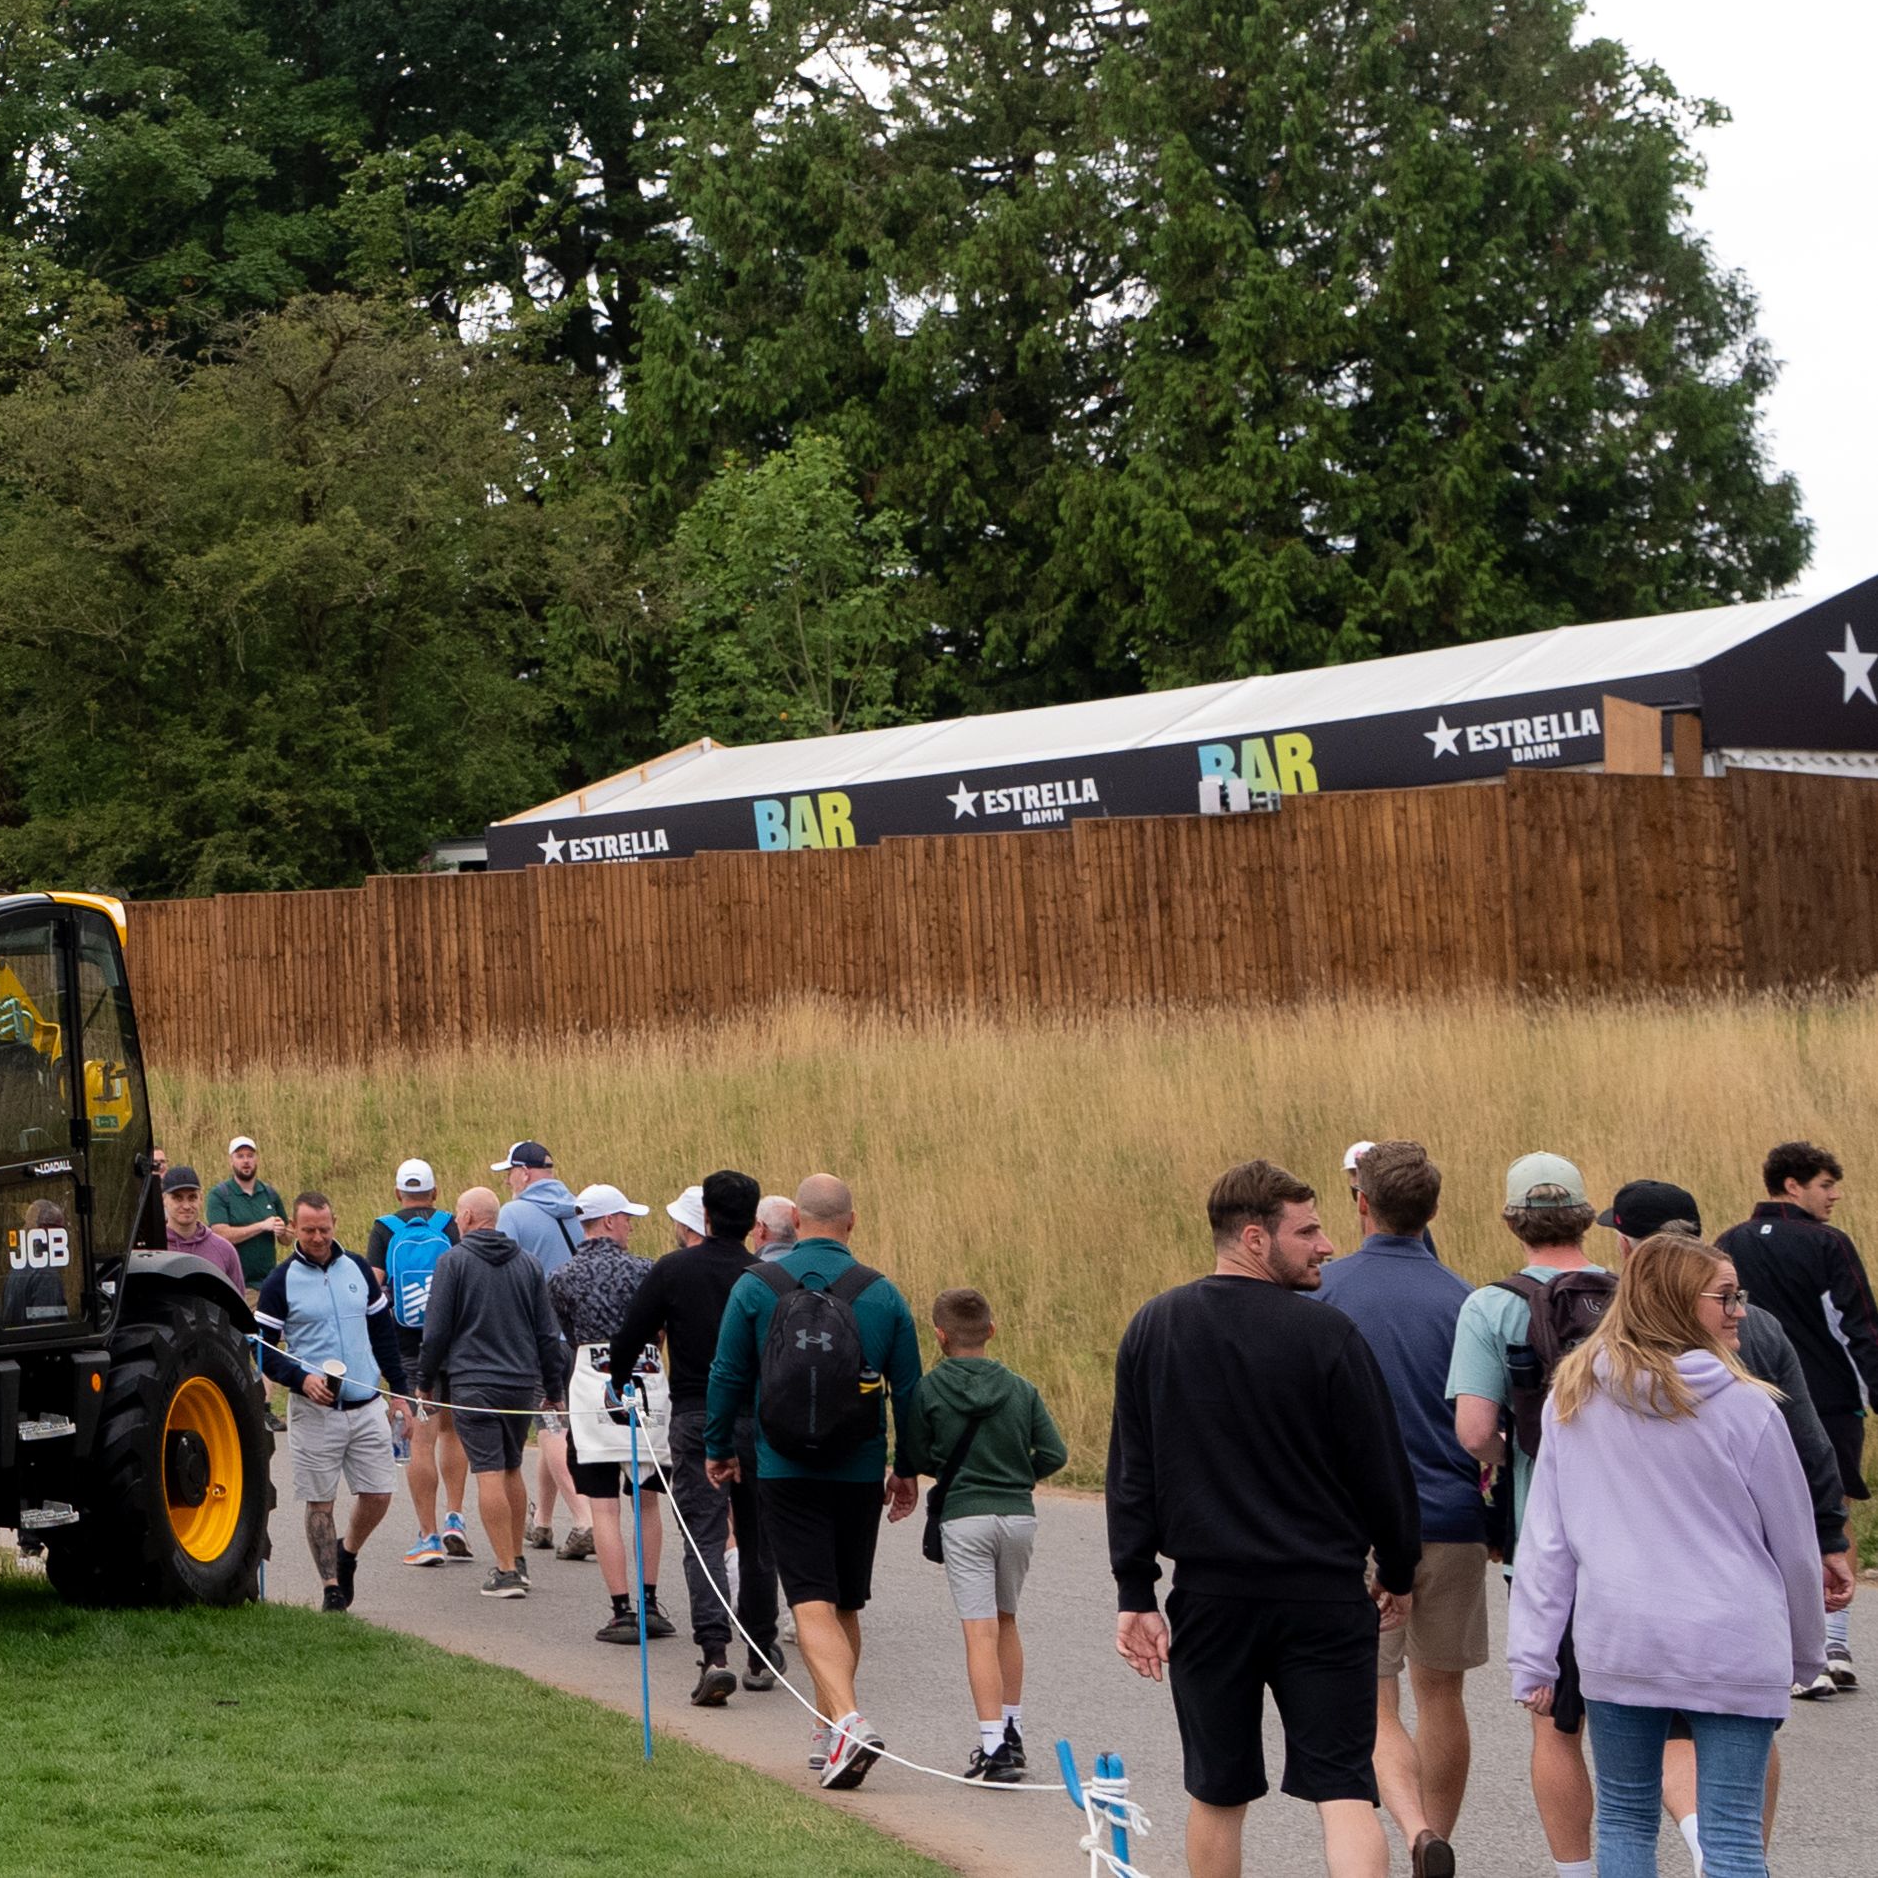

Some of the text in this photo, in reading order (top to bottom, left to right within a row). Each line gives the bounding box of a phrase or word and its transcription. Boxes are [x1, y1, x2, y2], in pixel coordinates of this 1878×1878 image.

[1466, 707, 1601, 754] ESTRELLA
[1197, 731, 1320, 800] BAR
[1511, 743, 1561, 763] DAMM
[982, 777, 1100, 815] ESTRELLA
[1021, 806, 1065, 826] DAMM
[753, 791, 857, 851] BAR
[568, 828, 670, 862] ESTRELLA
[9, 1227, 70, 1270] JCB
